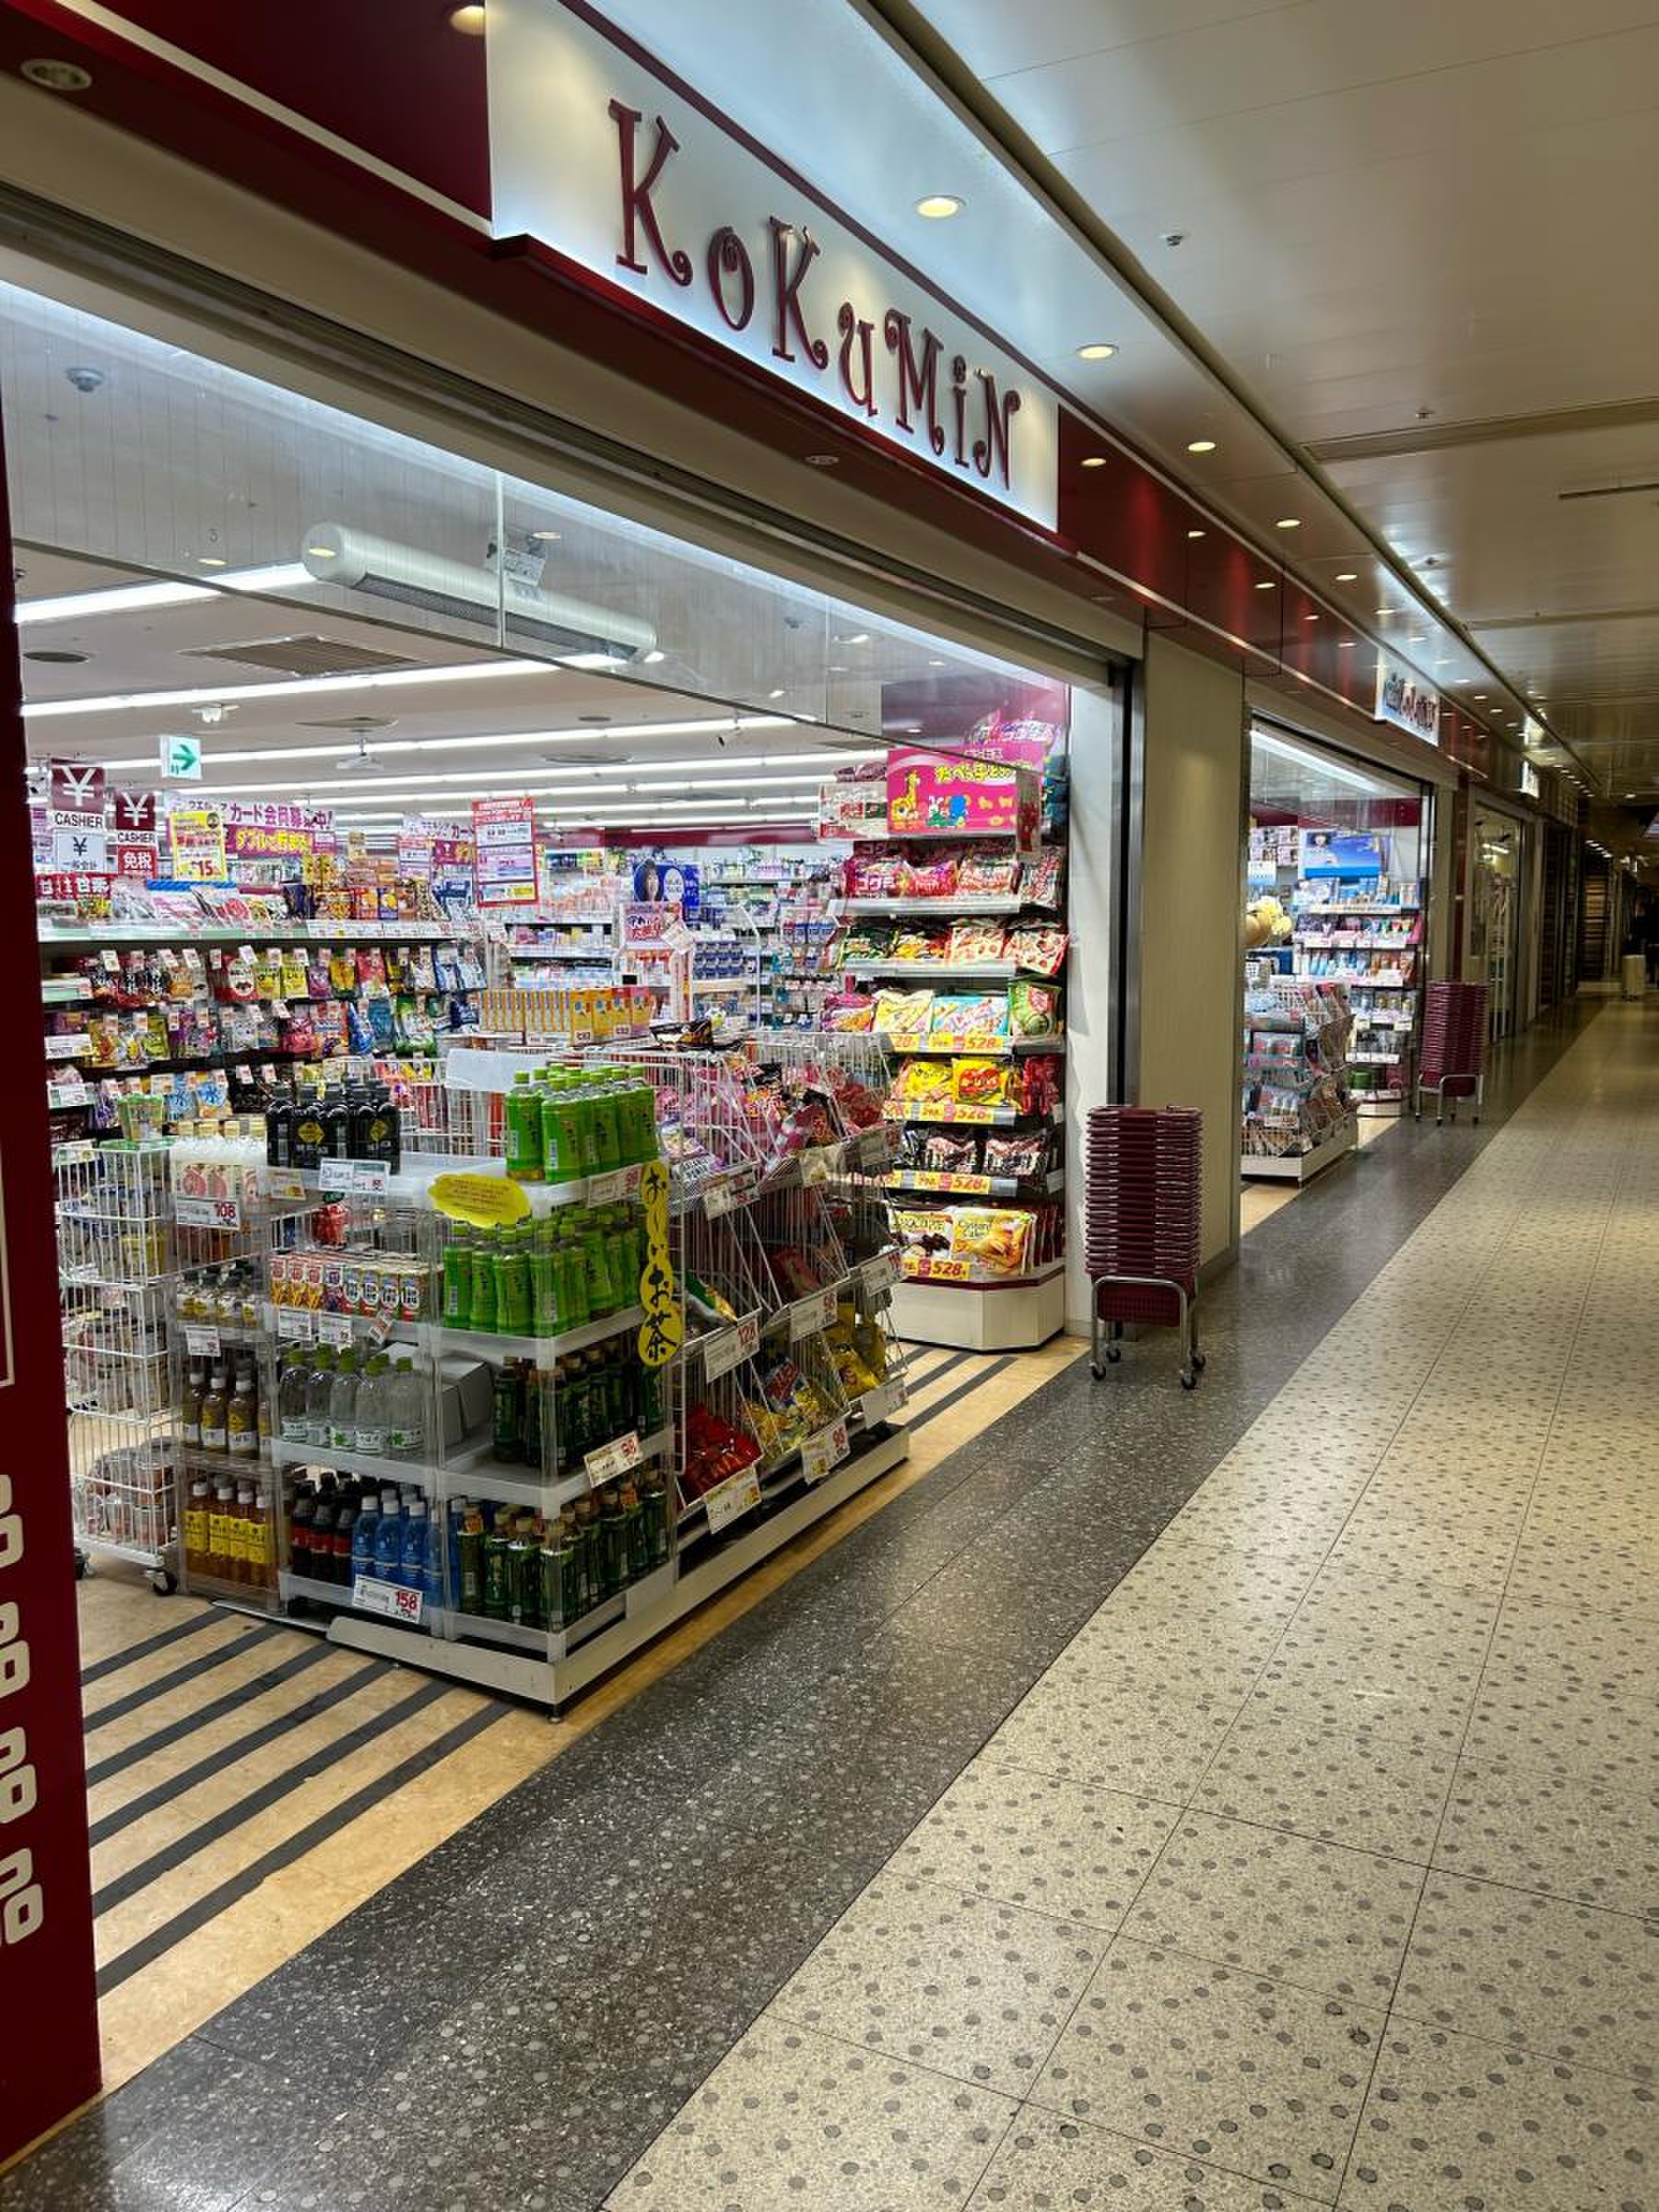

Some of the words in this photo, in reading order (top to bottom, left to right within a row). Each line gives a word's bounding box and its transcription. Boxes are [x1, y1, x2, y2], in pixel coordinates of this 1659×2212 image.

[55, 812, 103, 829] CASHIER
[117, 831, 155, 842] CASHIER
[123, 851, 152, 870] 免税
[968, 1036, 997, 1050] 528
[952, 1175, 984, 1191] 528
[213, 1202, 237, 1219] 108
[932, 1259, 963, 1277] 528
[395, 1591, 418, 1609] 158
